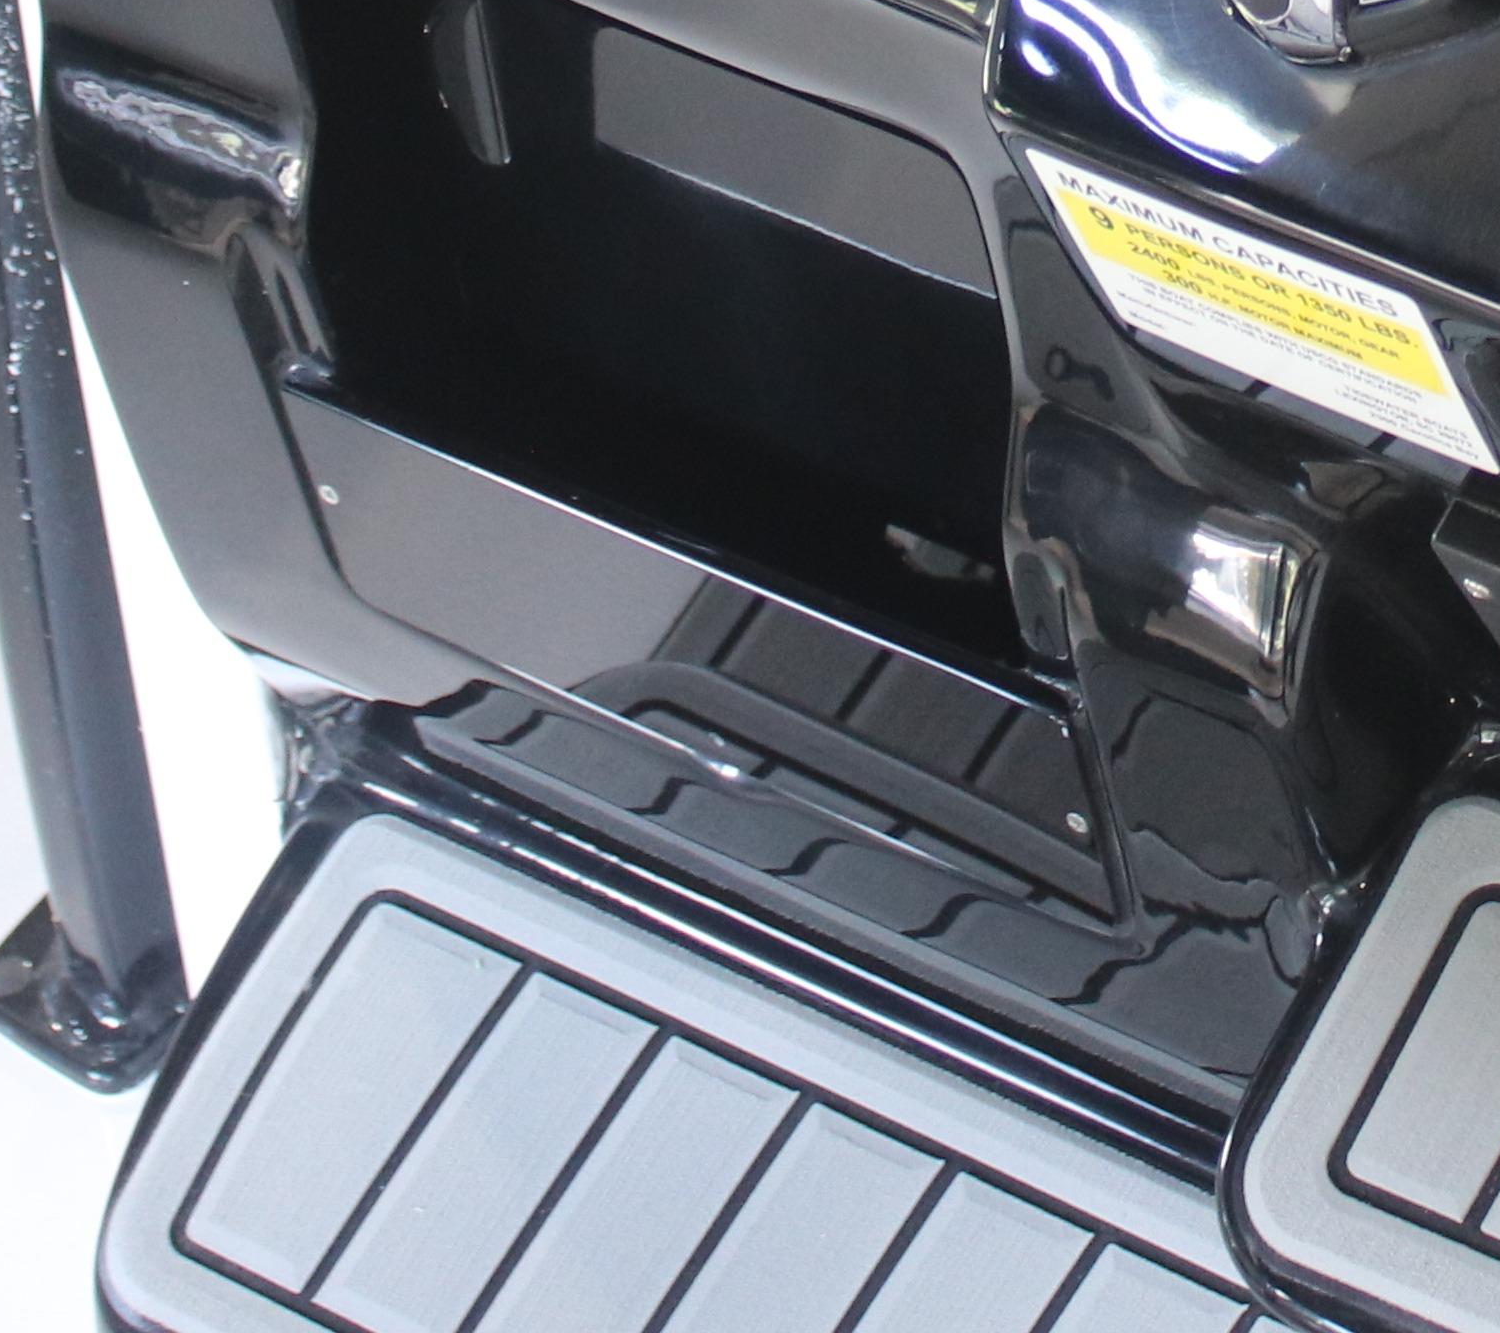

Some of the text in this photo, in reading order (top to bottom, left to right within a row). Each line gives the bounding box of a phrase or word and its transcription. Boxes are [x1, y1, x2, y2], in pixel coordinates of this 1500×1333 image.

[1057, 171, 1399, 317] MAXIMUM CAPACITIES
[1088, 206, 1419, 348] 9 PERSONS OR 1350 LBS.
[1128, 241, 1181, 271] 2400
[1162, 270, 1203, 294] 300
